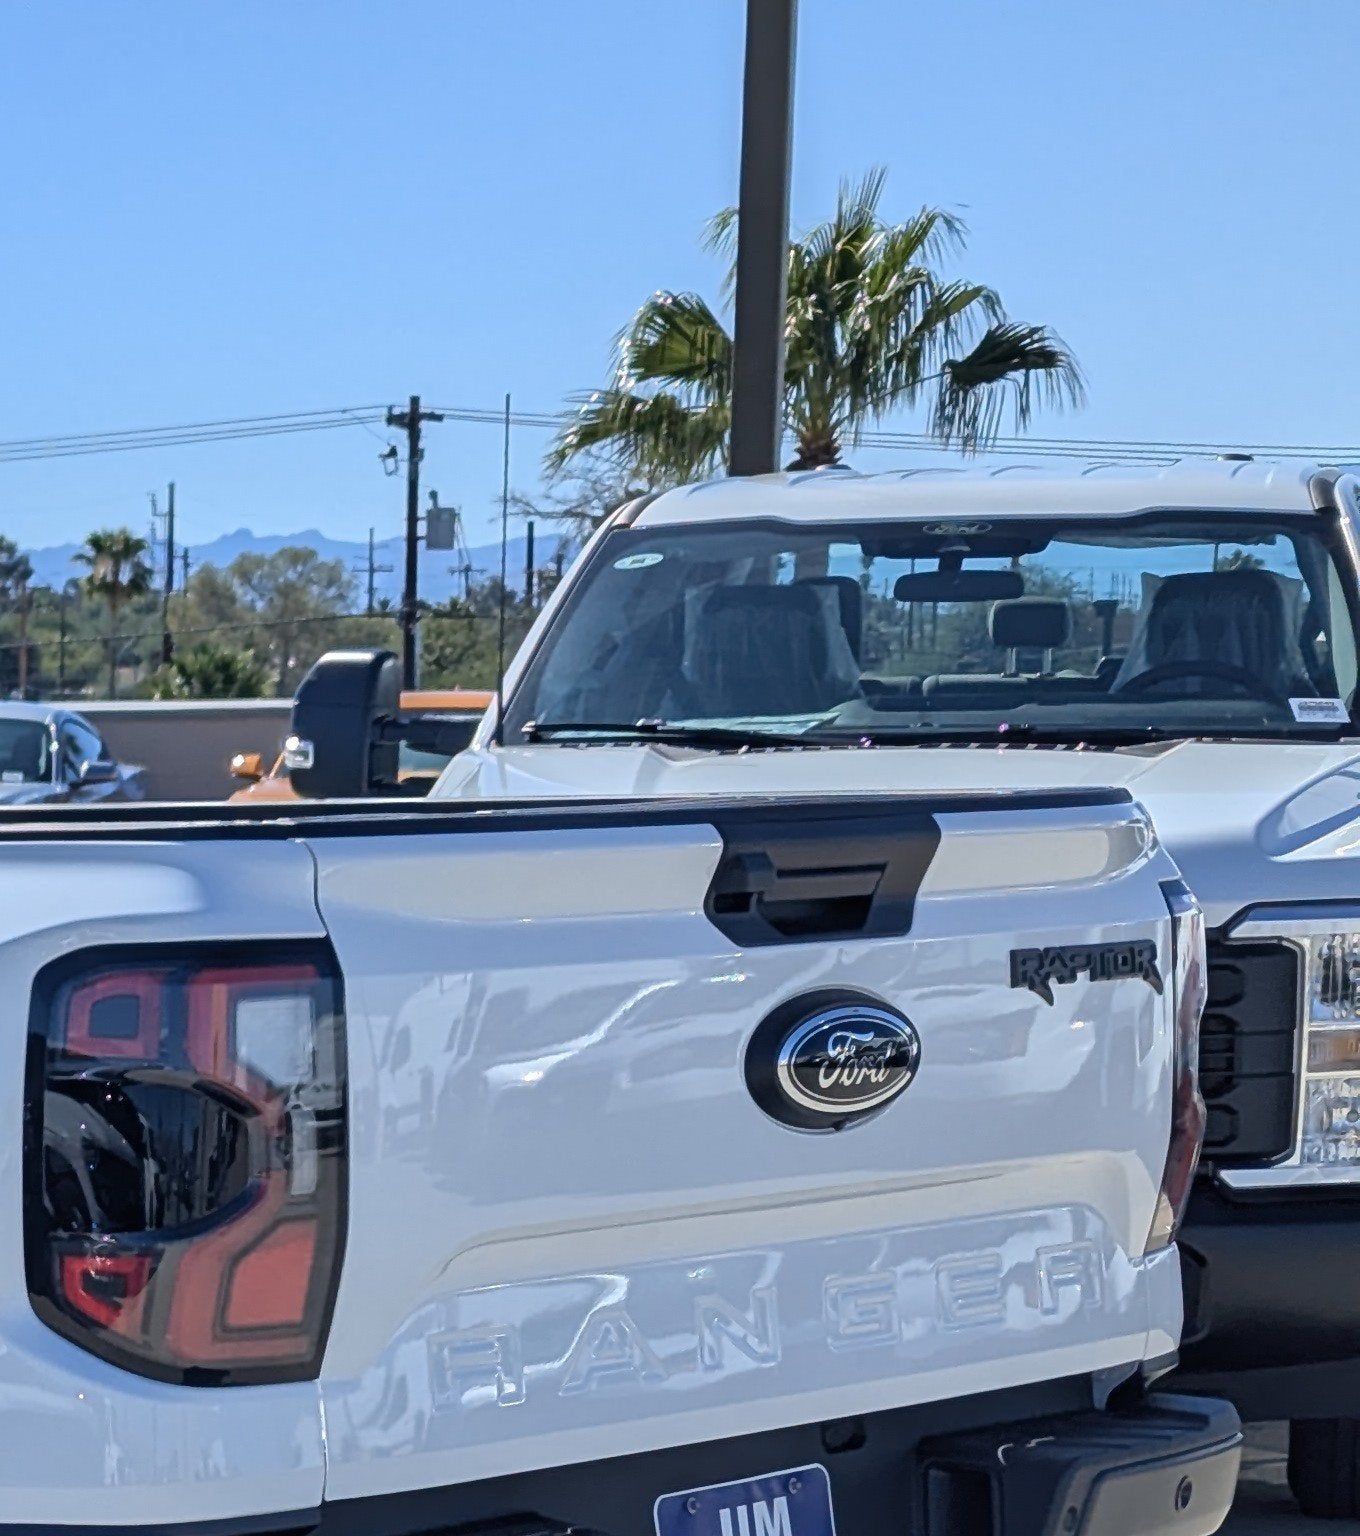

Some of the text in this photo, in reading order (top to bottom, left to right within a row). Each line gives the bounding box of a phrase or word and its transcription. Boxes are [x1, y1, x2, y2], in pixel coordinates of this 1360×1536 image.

[1010, 939, 1163, 1006] RAPTOR
[819, 1031, 898, 1089] Ford
[427, 1239, 1103, 1411] RANGER
